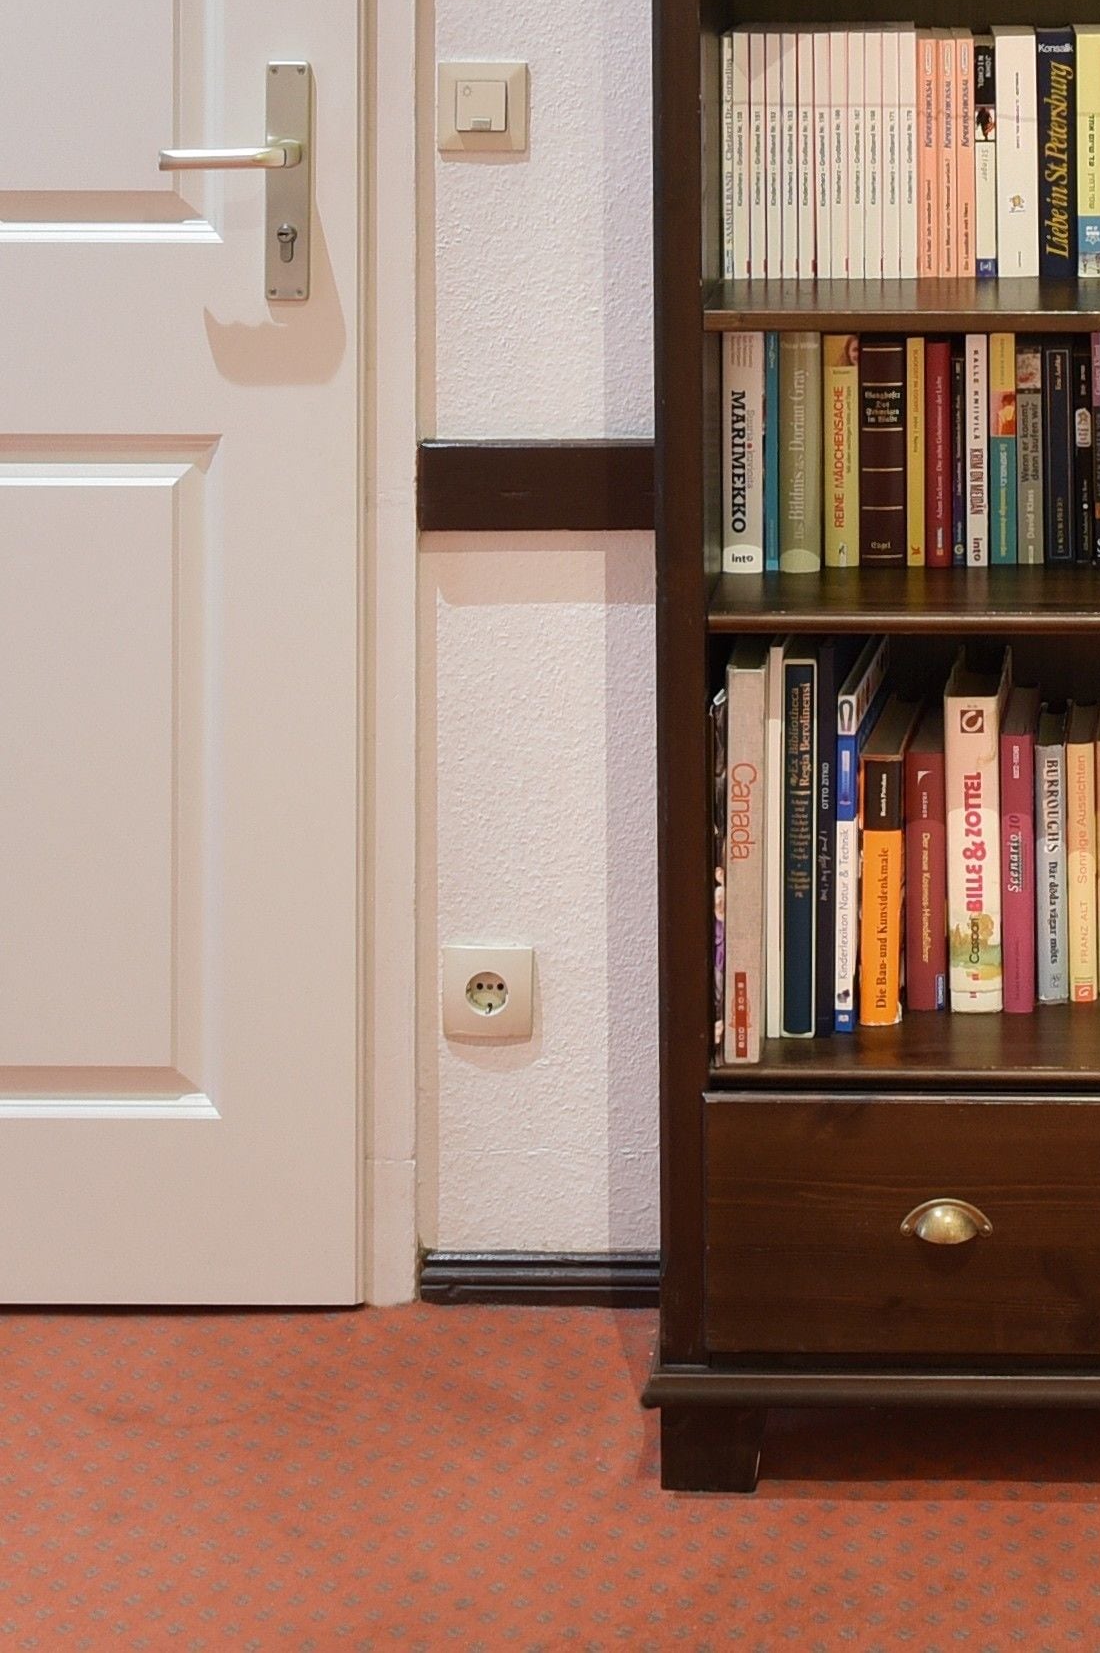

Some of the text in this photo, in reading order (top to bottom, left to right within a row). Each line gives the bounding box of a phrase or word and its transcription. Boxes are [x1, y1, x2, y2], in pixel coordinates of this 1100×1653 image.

[724, 59, 732, 119] Dr. Cornelius
[976, 55, 984, 89] NICHOL
[984, 55, 992, 77] JOHN
[980, 147, 990, 181] Stinger
[1042, 61, 1072, 257] Liebe in St. Petersburg
[732, 391, 746, 533] MARIMEKKO
[788, 369, 810, 519] Bildnis Dorian Gray
[830, 385, 844, 529] REINE MÄDCHENSACHE
[970, 447, 984, 469] KRIM
[1020, 401, 1030, 483] Wenn er kommt,
[1030, 403, 1040, 481] dann laufen wir
[972, 537, 982, 561] into
[1026, 515, 1036, 539] David
[788, 687, 800, 755] Bibliotheca
[800, 683, 812, 787] Regia Berolinensi
[730, 763, 756, 861] Canada
[820, 763, 830, 809] OTTO ZITKO
[962, 771, 986, 911] BILLE & ZOTTEL
[1006, 815, 1022, 893] Scenario 10
[1044, 759, 1062, 965] BURROUGHS Där döda vägar möts
[1076, 755, 1088, 963] FRANZ ALT Sonnige Aussichten
[840, 829, 850, 979] Kinderlexikon Natur & Technik
[874, 847, 890, 1009] Die Kunstdenkmale
[922, 831, 930, 963] Der neue Kosmos-Hundeführer
